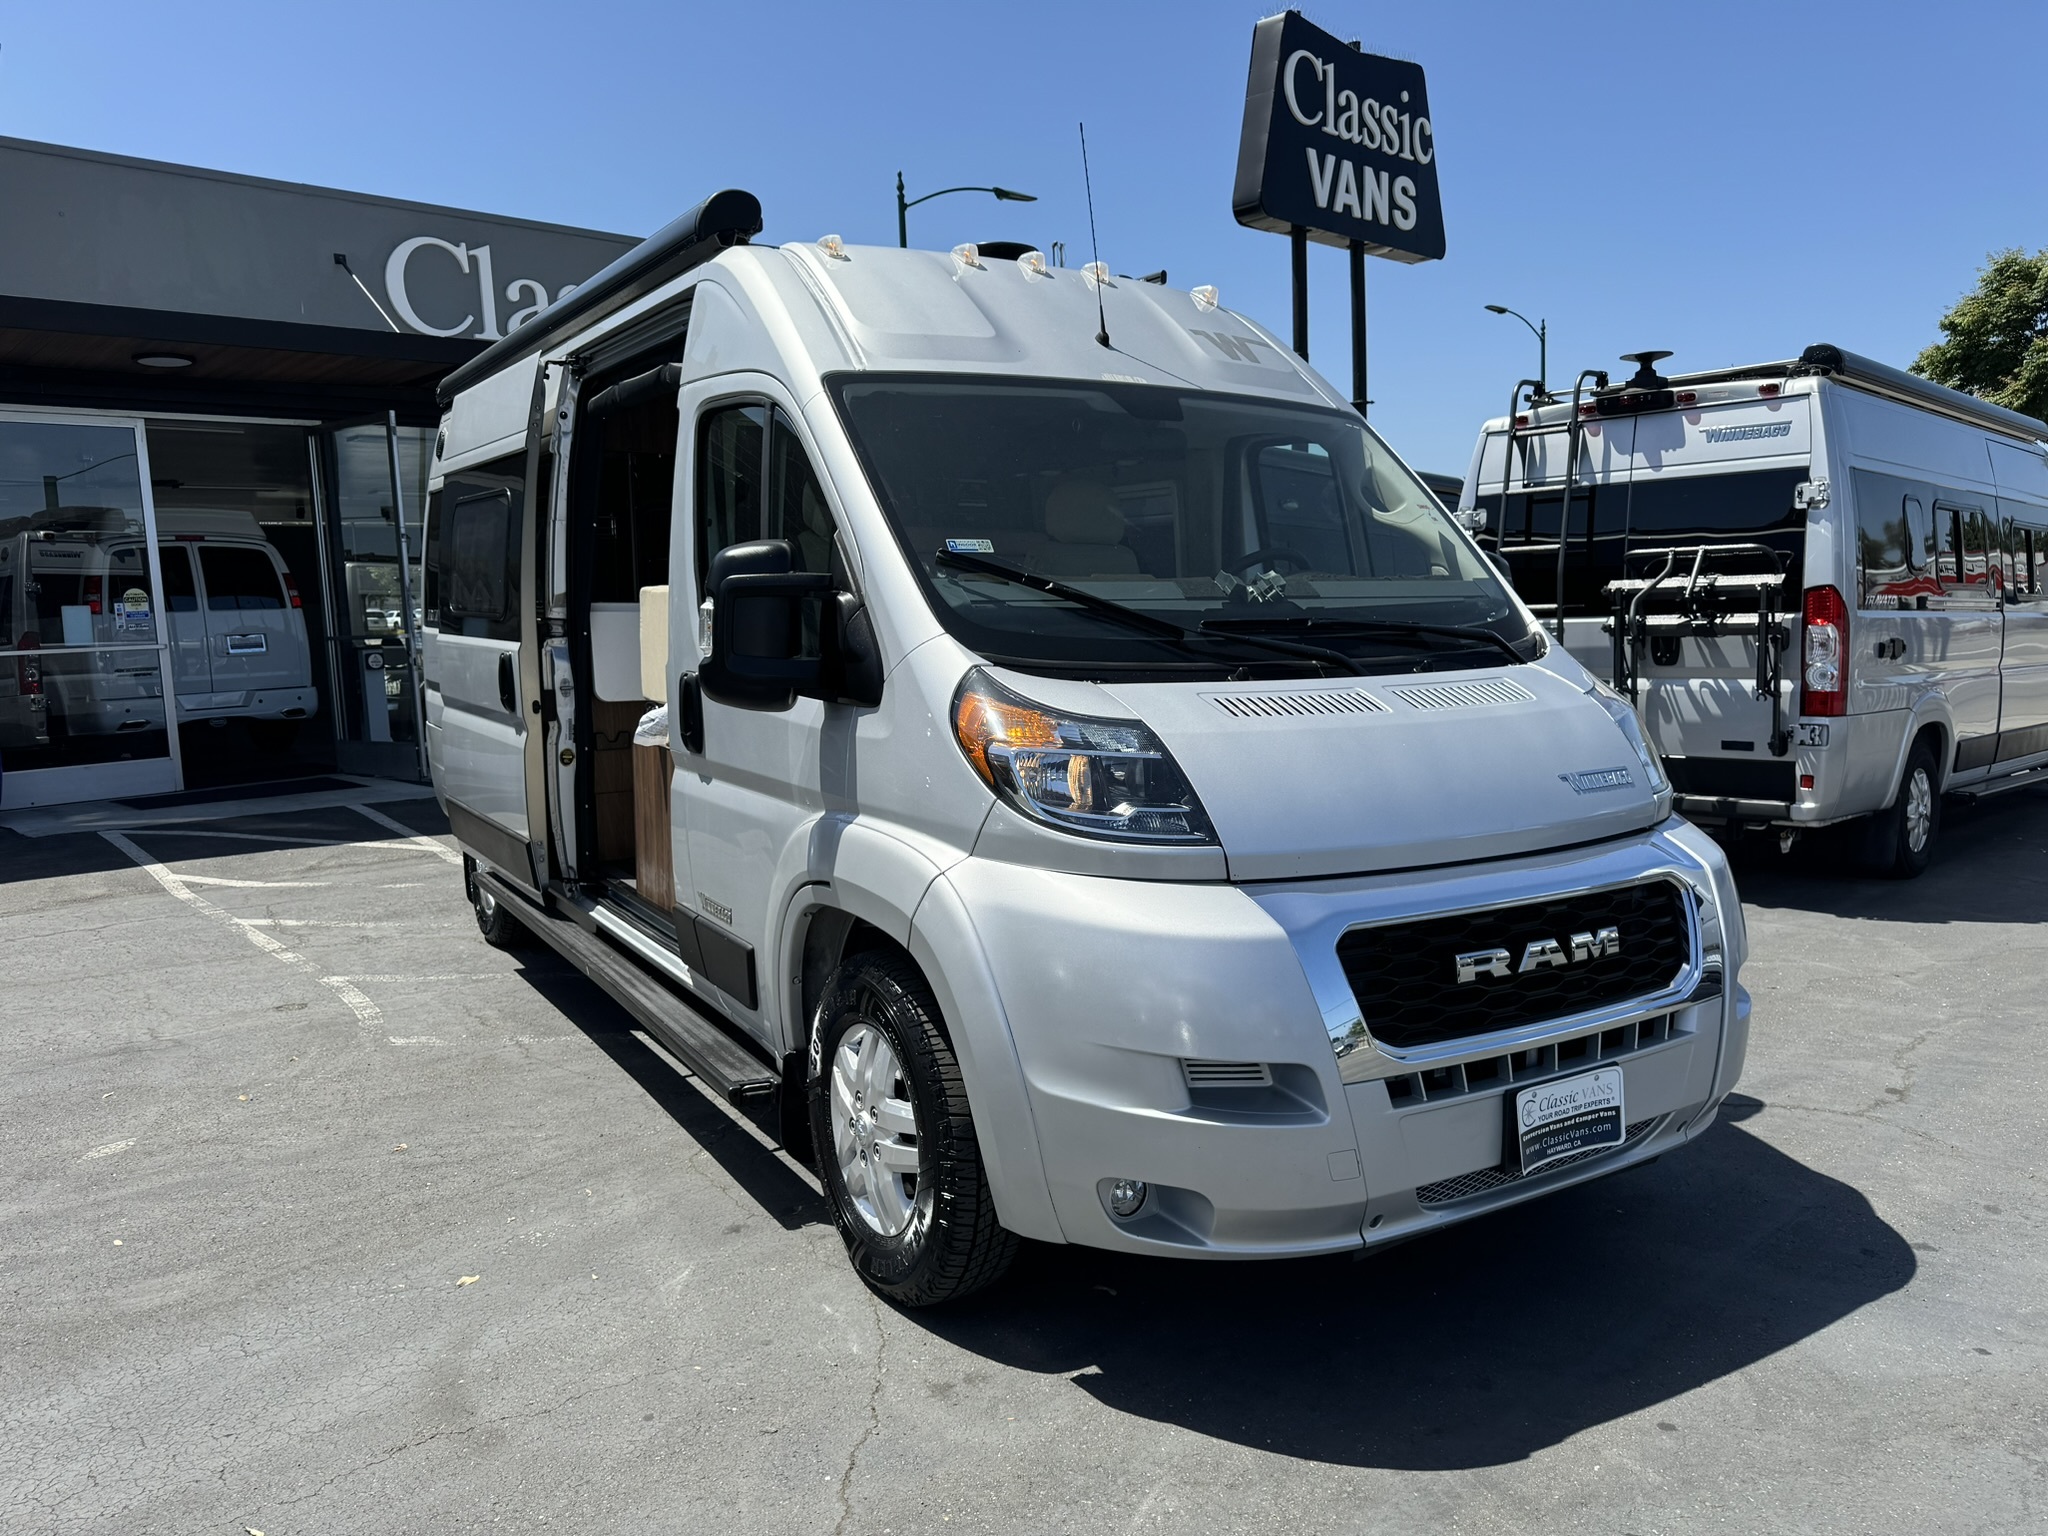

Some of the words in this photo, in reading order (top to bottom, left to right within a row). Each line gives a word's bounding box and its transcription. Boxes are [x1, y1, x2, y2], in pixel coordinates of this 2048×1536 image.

[1284, 50, 1433, 165] Classic
[1306, 147, 1417, 231] VANS
[385, 236, 579, 341] Cla
[1699, 420, 1792, 443] WINNEBAGO
[1865, 594, 1898, 606] TRAVATO
[1456, 926, 1620, 984] RAM
[1538, 1113, 1553, 1122] YOUR
[1554, 1108, 1570, 1118] ROAD
[1571, 1104, 1583, 1113] TRIP
[1539, 1090, 1578, 1112] Classic
[1582, 1083, 1613, 1099] VANS
[1522, 1126, 1549, 1142] Conversion
[1550, 1122, 1563, 1131] Vans
[1564, 1118, 1574, 1127] and
[1575, 1113, 1599, 1123] Camper
[1600, 1110, 1616, 1118] Vans
[1525, 1123, 1612, 1155] www.ClassicVans.com
[1546, 1142, 1573, 1155] HAYWARD,
